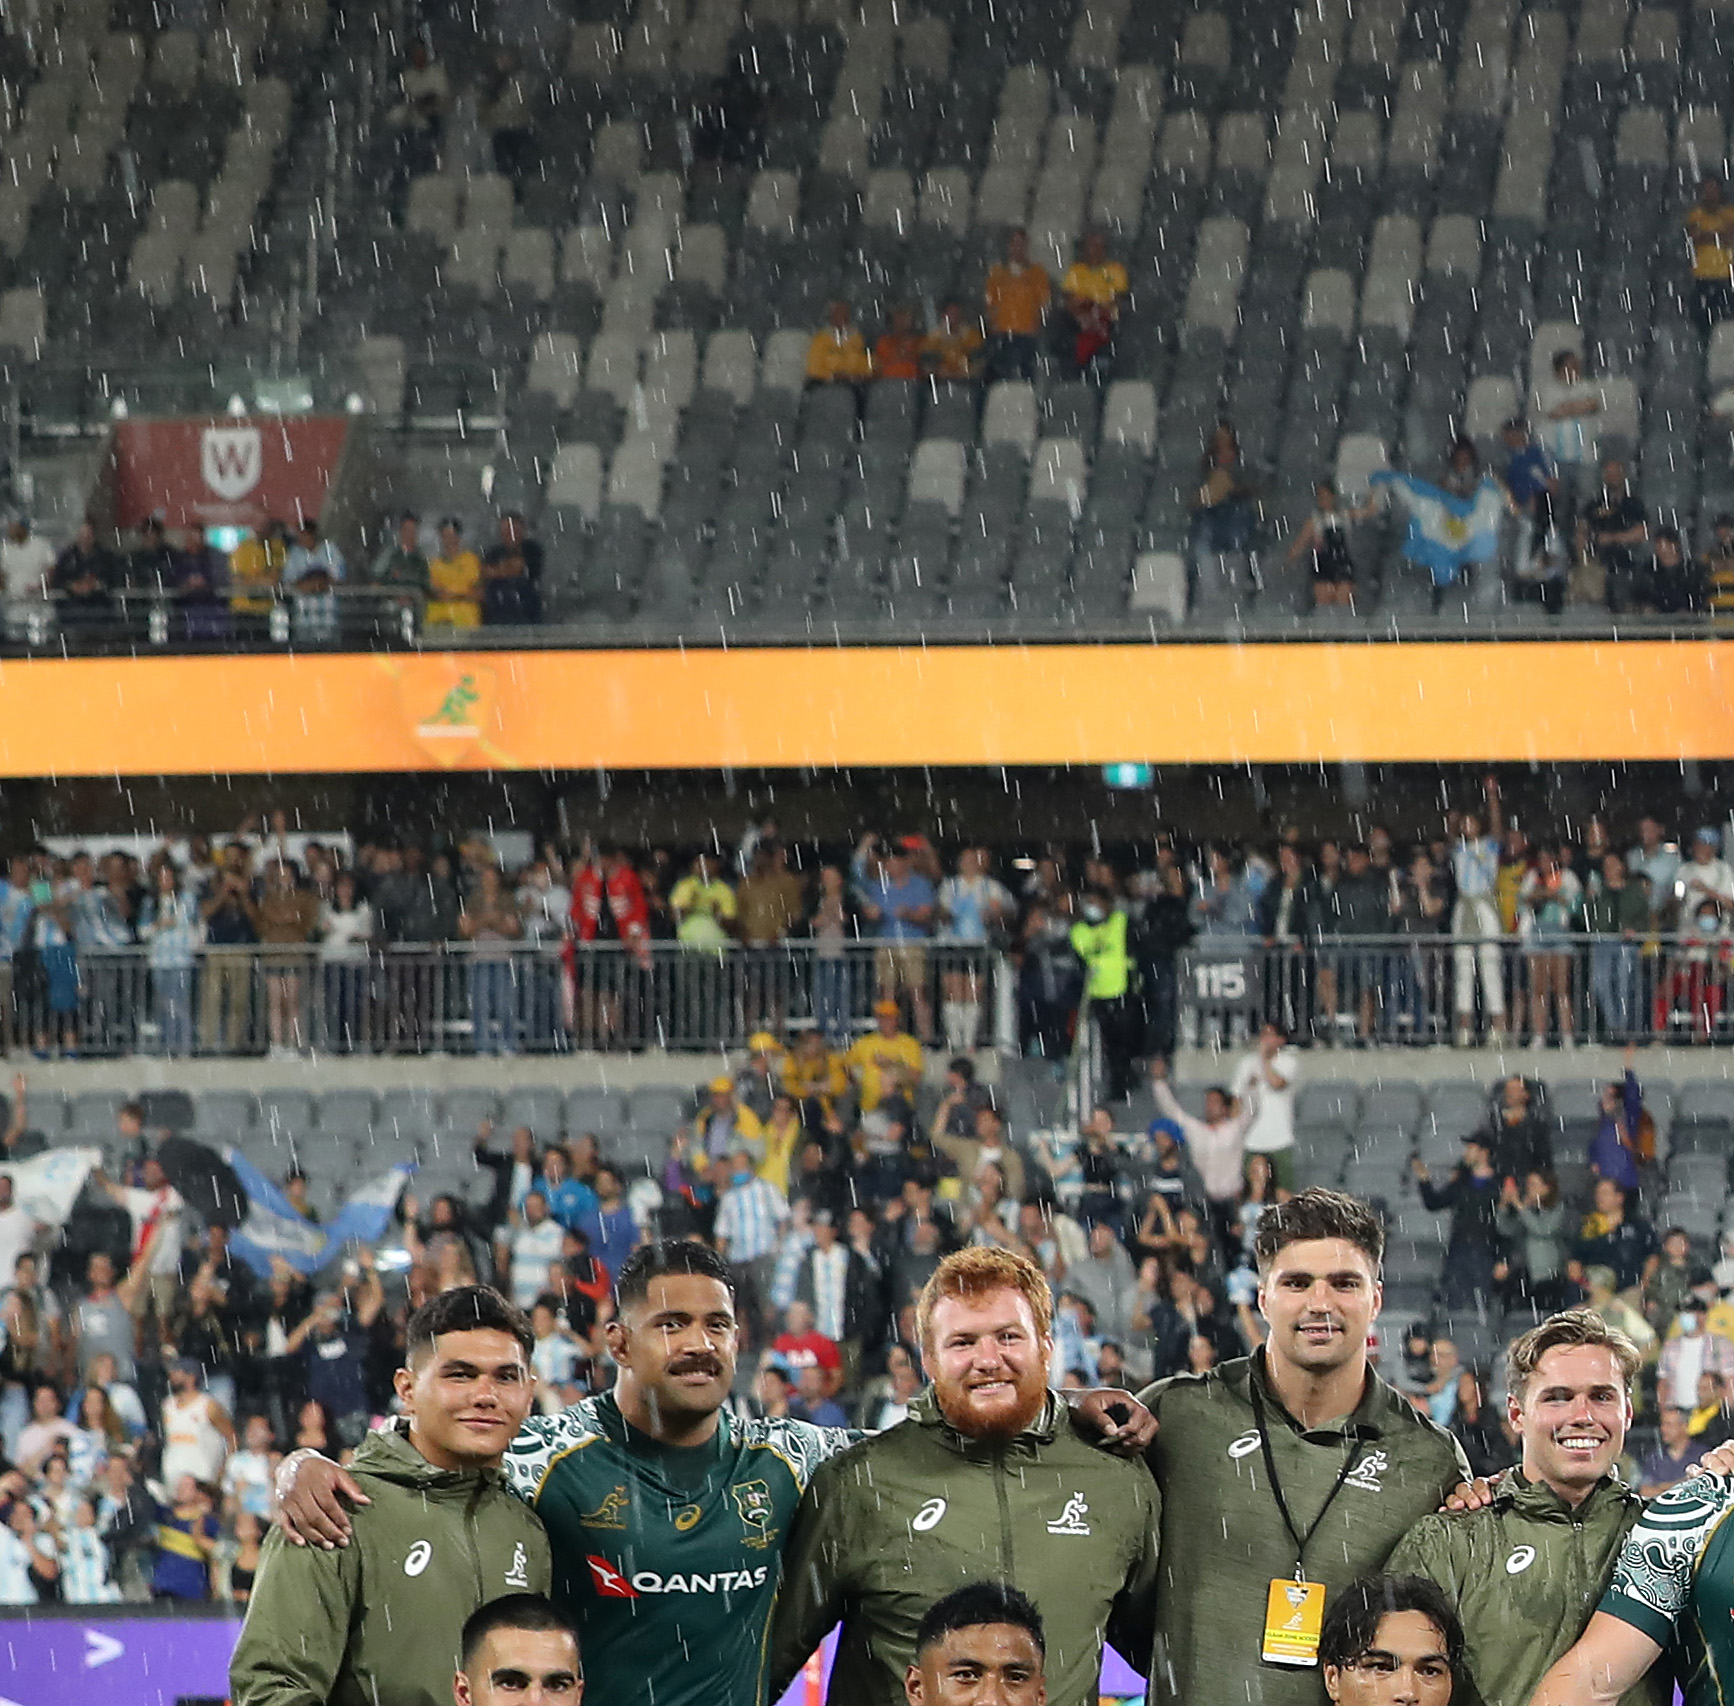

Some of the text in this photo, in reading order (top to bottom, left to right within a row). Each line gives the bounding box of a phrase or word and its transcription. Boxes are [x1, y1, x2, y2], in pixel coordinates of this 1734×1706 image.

[209, 441, 252, 479] W
[1195, 963, 1246, 998] 115
[632, 1566, 768, 1593] QANTAS
